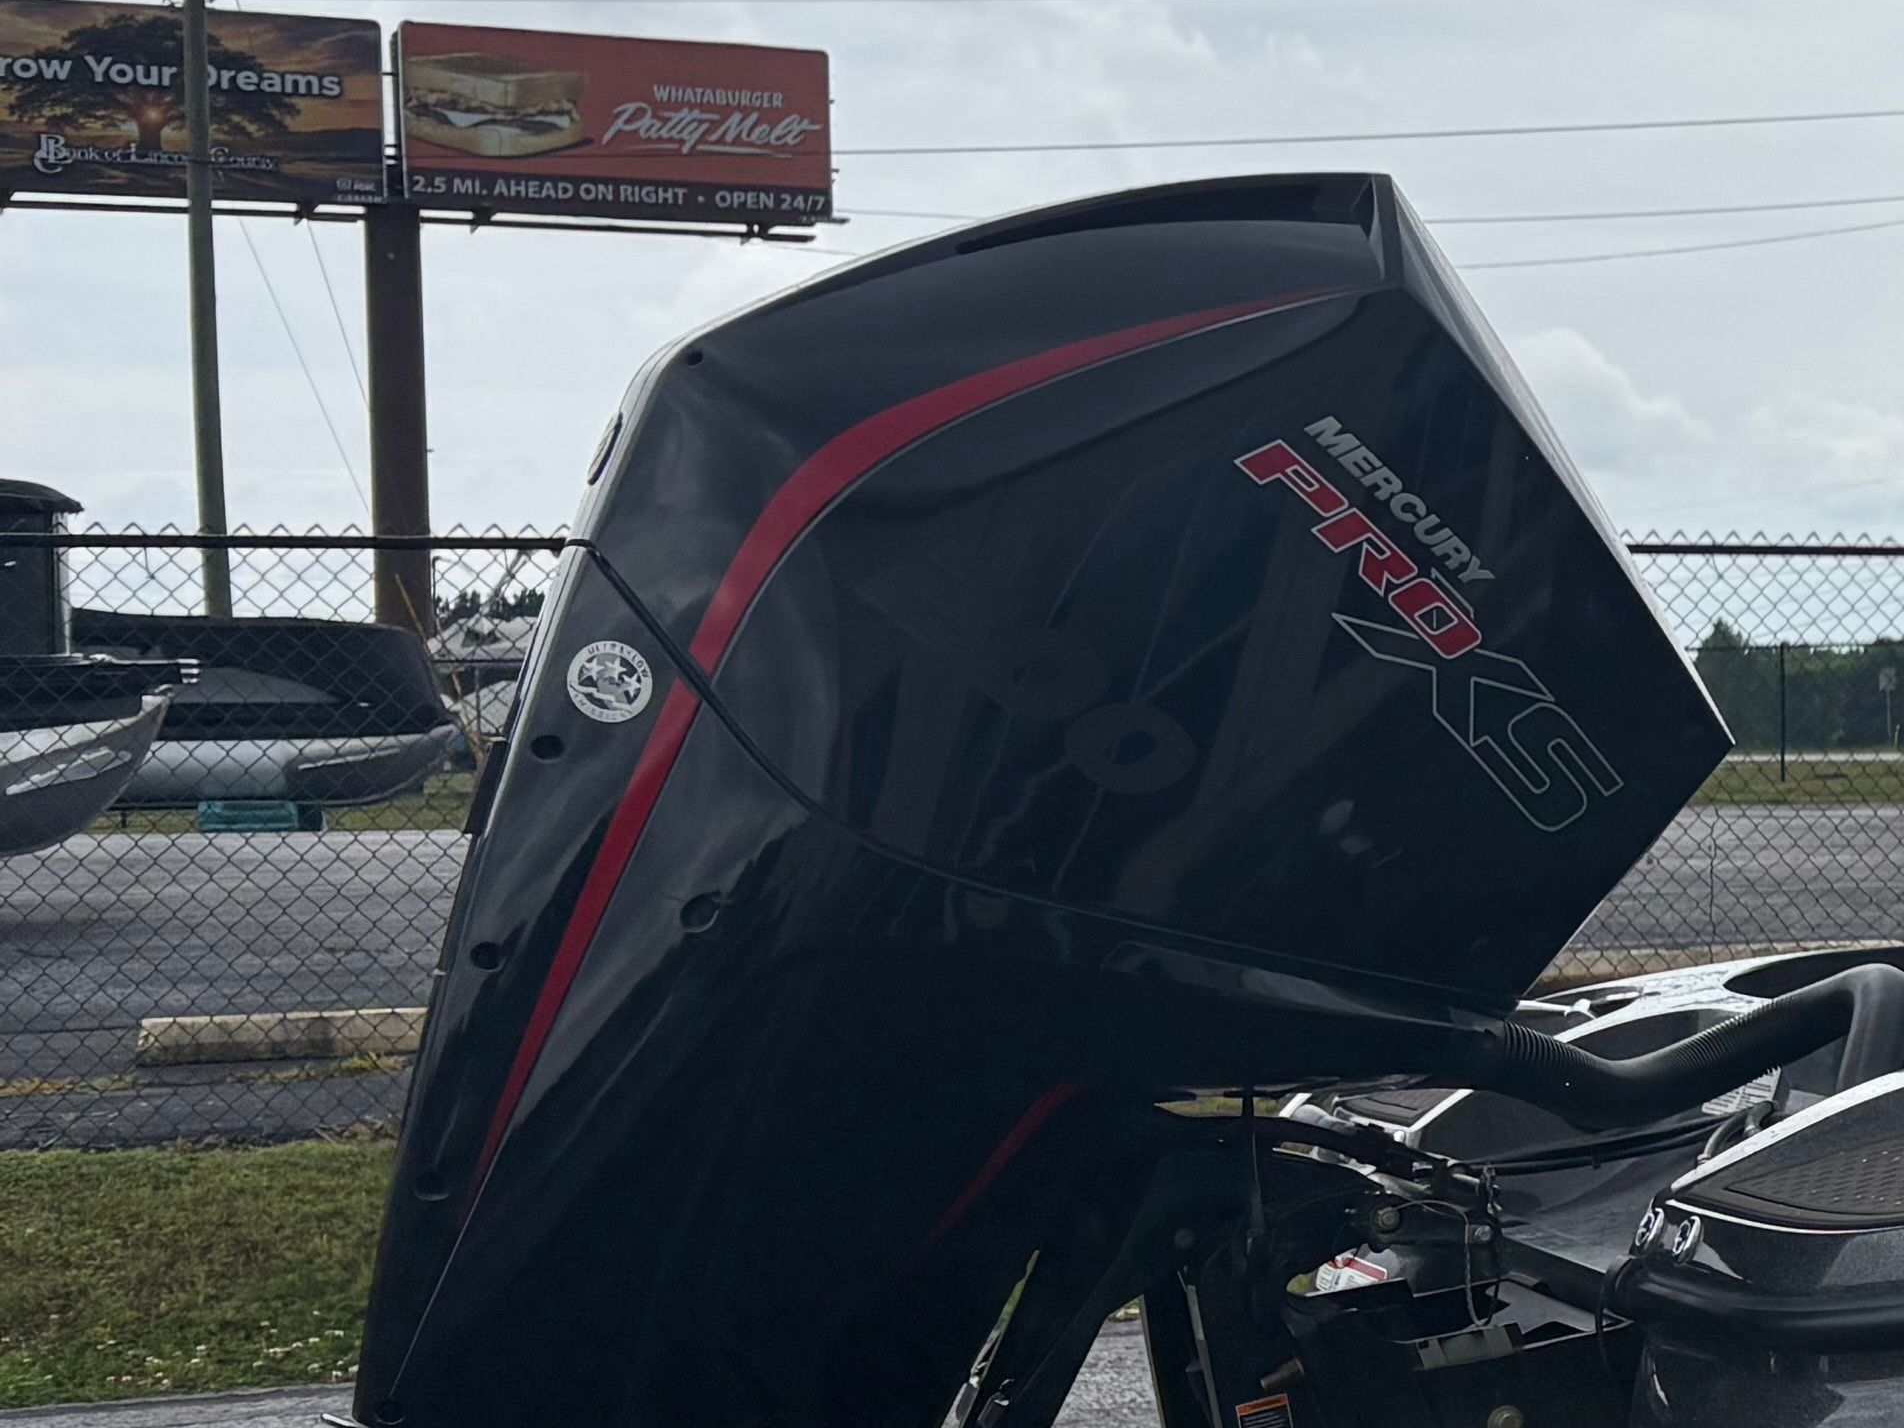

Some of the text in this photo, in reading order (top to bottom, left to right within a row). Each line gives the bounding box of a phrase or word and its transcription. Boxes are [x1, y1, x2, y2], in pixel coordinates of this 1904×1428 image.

[0, 58, 73, 80] row
[84, 55, 178, 87] Your
[653, 84, 785, 109] WHATABURGER
[603, 103, 822, 154] Patty Melt
[412, 176, 826, 212] 2.5 MI. AHEAD ON RIGHT OPEN 24/7
[1303, 415, 1497, 585] MERCURY
[1234, 439, 1624, 831] PRO XS
